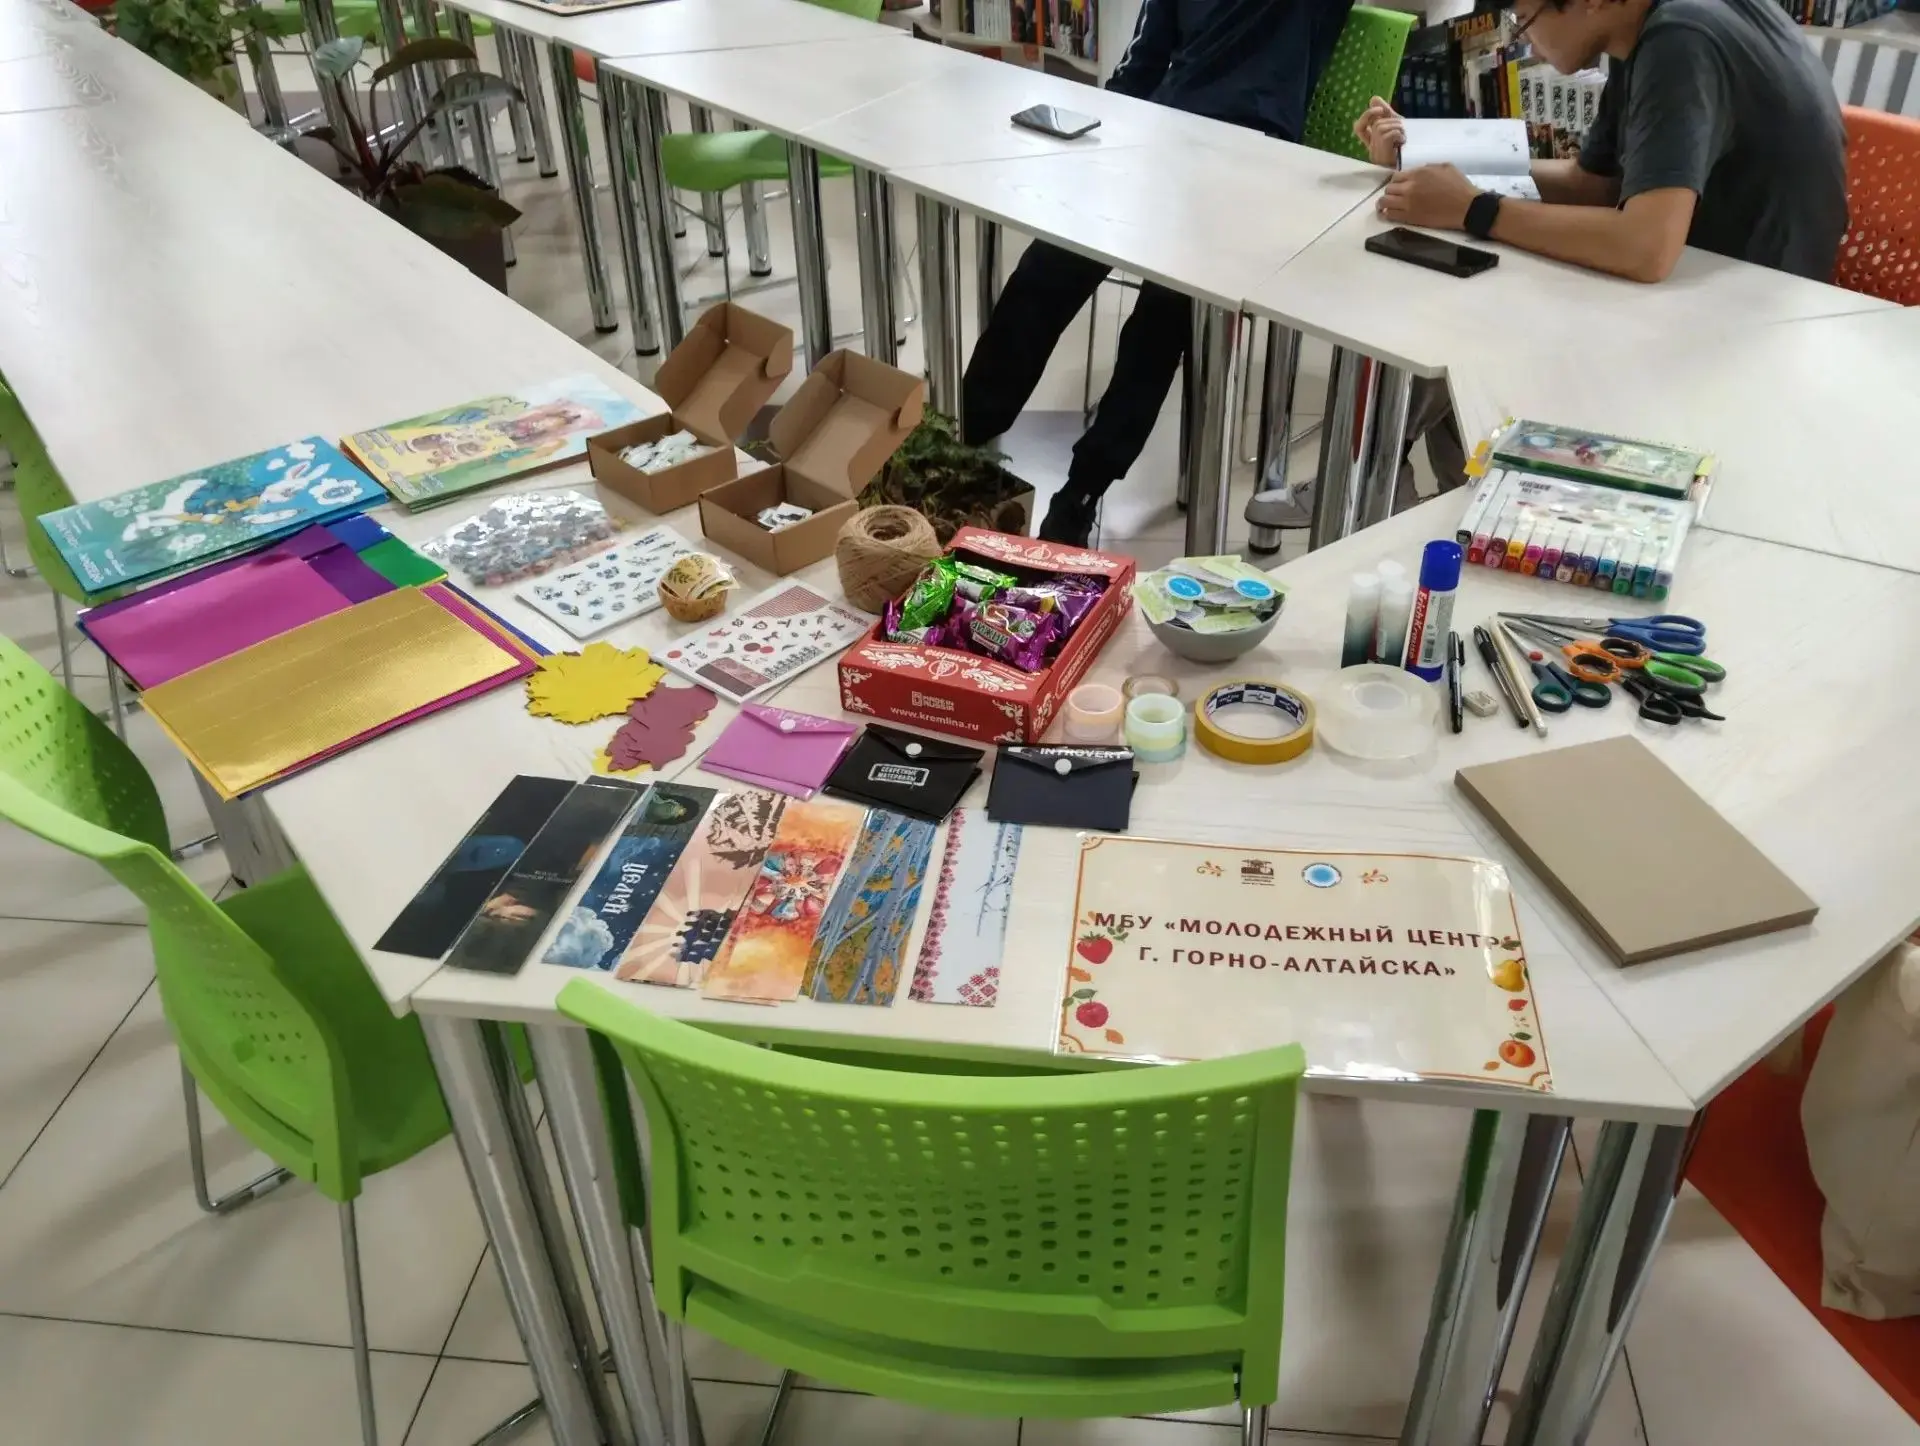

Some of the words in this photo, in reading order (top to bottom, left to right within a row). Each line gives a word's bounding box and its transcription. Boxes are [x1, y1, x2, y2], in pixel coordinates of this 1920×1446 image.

[890, 707, 979, 731] www.kremlina.ru
[1040, 747, 1122, 759] INTROVERT
[1094, 912, 1153, 929] МБУ
[1164, 918, 1394, 943] «МОЛОДЕЖНЫЙ
[1139, 946, 1159, 962] Г.
[1172, 948, 1457, 976] ГОРНО-АЛТАЙСКА»
